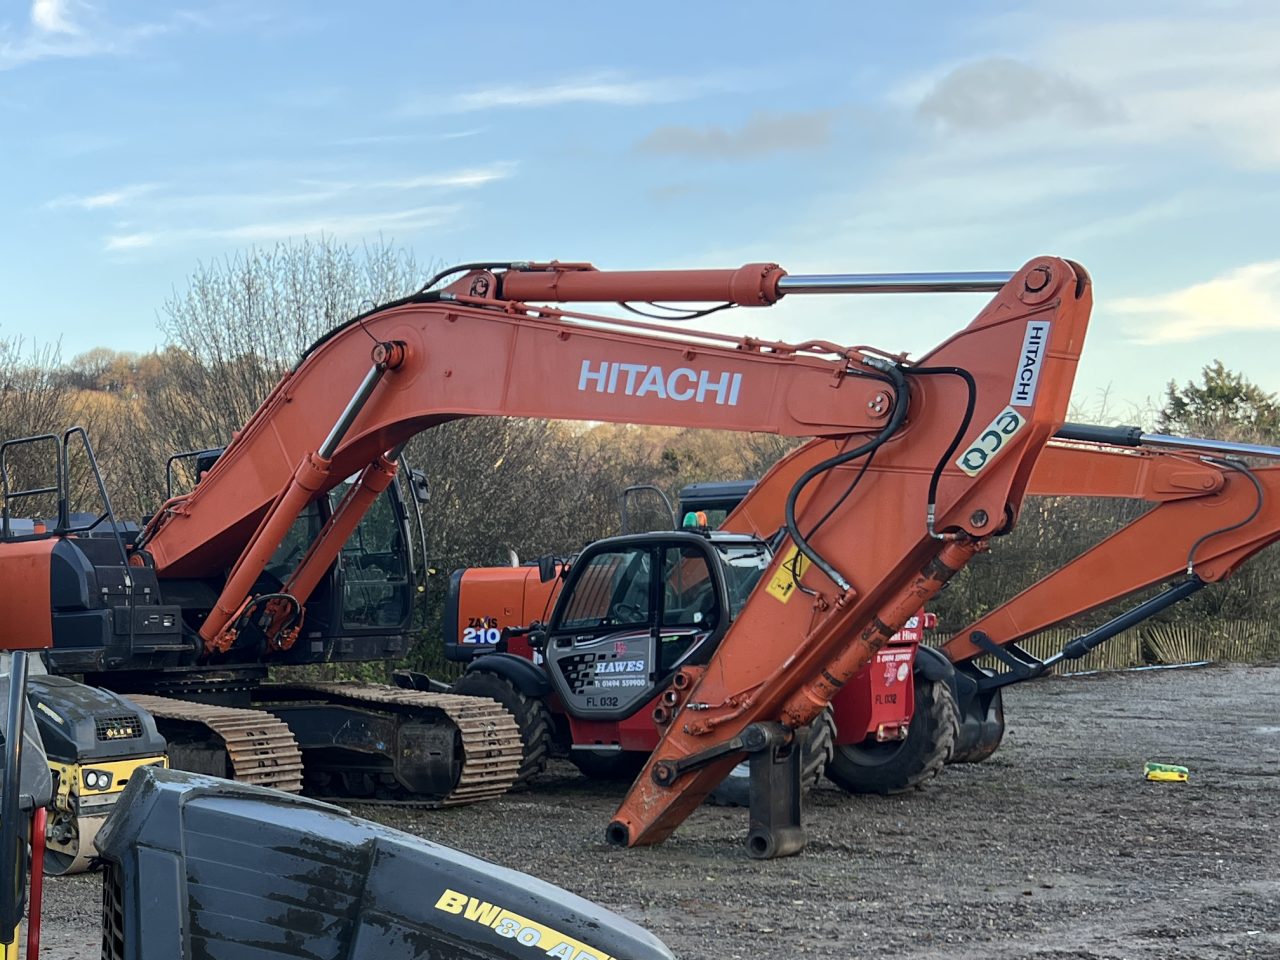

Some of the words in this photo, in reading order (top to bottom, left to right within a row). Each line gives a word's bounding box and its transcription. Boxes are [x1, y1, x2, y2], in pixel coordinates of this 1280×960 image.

[1016, 326, 1044, 401] HITACHI
[577, 359, 743, 406] HITACHI
[962, 411, 1020, 471] eco
[463, 627, 501, 644] 210
[594, 660, 645, 673] HAWES
[602, 680, 620, 688] 01494
[622, 679, 646, 687] 559900
[586, 697, 598, 707] FL
[600, 697, 619, 707] 032
[434, 888, 541, 947] BW80
